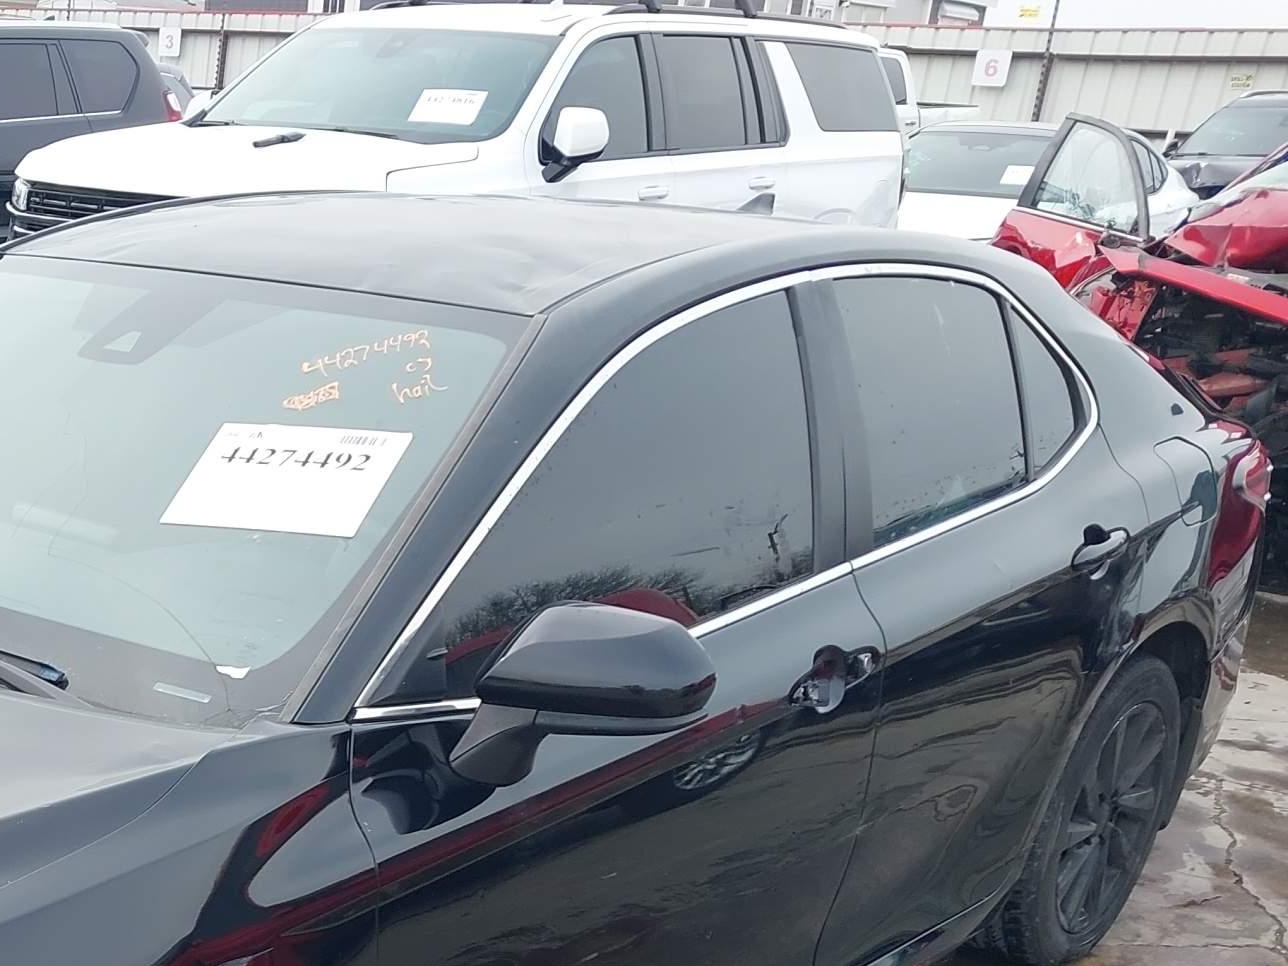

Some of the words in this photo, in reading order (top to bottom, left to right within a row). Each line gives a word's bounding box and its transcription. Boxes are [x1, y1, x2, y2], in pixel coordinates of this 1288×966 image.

[165, 34, 174, 49] 3
[984, 59, 999, 77] 6
[301, 329, 431, 377] 44274492
[391, 374, 449, 404] hail
[220, 446, 372, 471] 44274492
